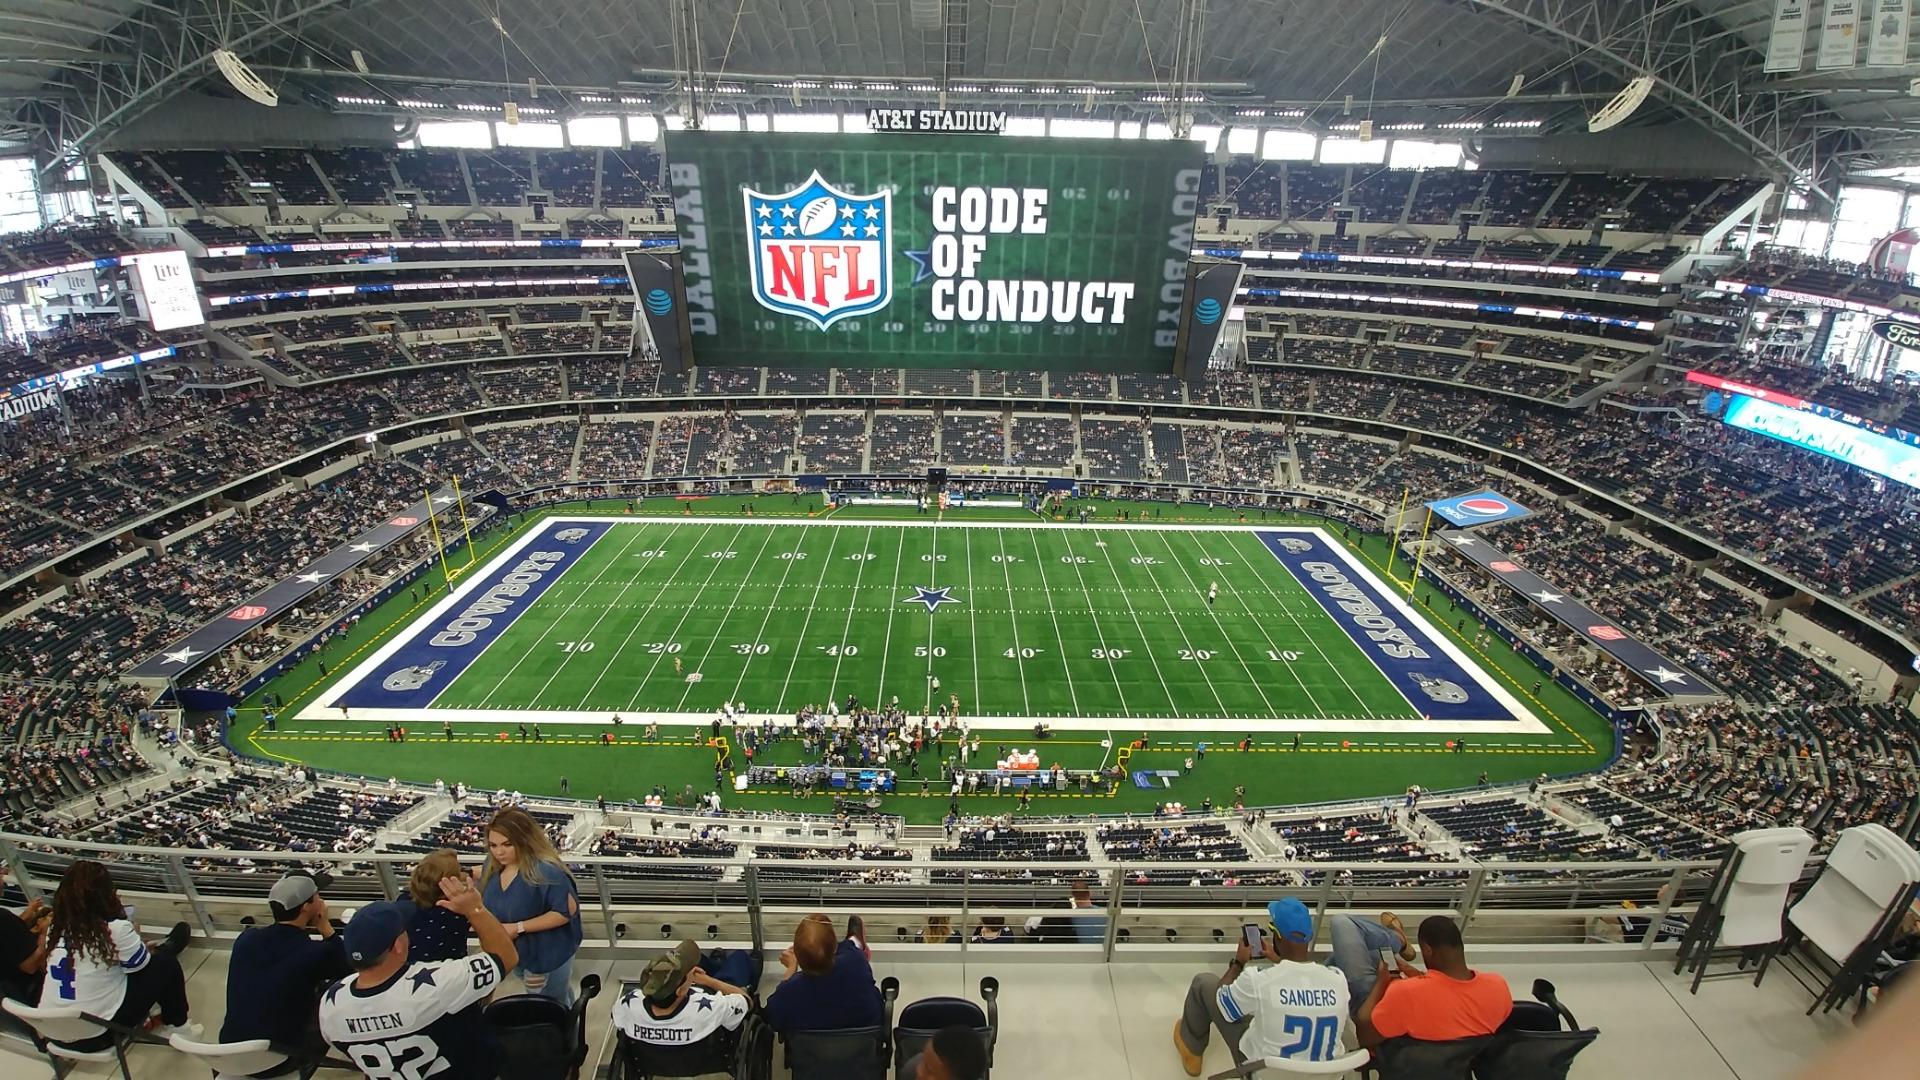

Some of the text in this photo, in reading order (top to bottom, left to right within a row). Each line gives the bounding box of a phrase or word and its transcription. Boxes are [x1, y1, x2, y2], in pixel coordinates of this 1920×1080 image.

[867, 109, 1007, 132] AT&T STADIUM
[932, 186, 1048, 234] CODE
[931, 233, 987, 278] OF
[1154, 168, 1202, 348] COWBOYS
[66, 274, 86, 291] Lite
[153, 264, 181, 282] Lite
[767, 245, 875, 308] NFL
[931, 279, 1135, 324] CONDUCT
[1767, 288, 1796, 299] REPORT
[1886, 324, 1920, 347] For
[429, 551, 566, 647] COWBOYS
[1300, 561, 1432, 660] COWBOYS
[561, 641, 595, 653] 10
[647, 642, 683, 654] 20
[735, 643, 770, 655] 30
[825, 644, 858, 656] 40
[913, 646, 947, 658] 50
[1002, 647, 1035, 659] 40
[1091, 648, 1123, 660] 30
[1177, 649, 1211, 661] 20
[1266, 650, 1299, 661] 10
[50, 957, 76, 1001] 4
[469, 955, 495, 991] 82
[1279, 988, 1337, 1007] SANDERS
[345, 1012, 404, 1034] WITTEN
[633, 1023, 693, 1042] PRESCOTT
[1280, 1014, 1339, 1063] 20
[347, 1034, 452, 1080] 82
